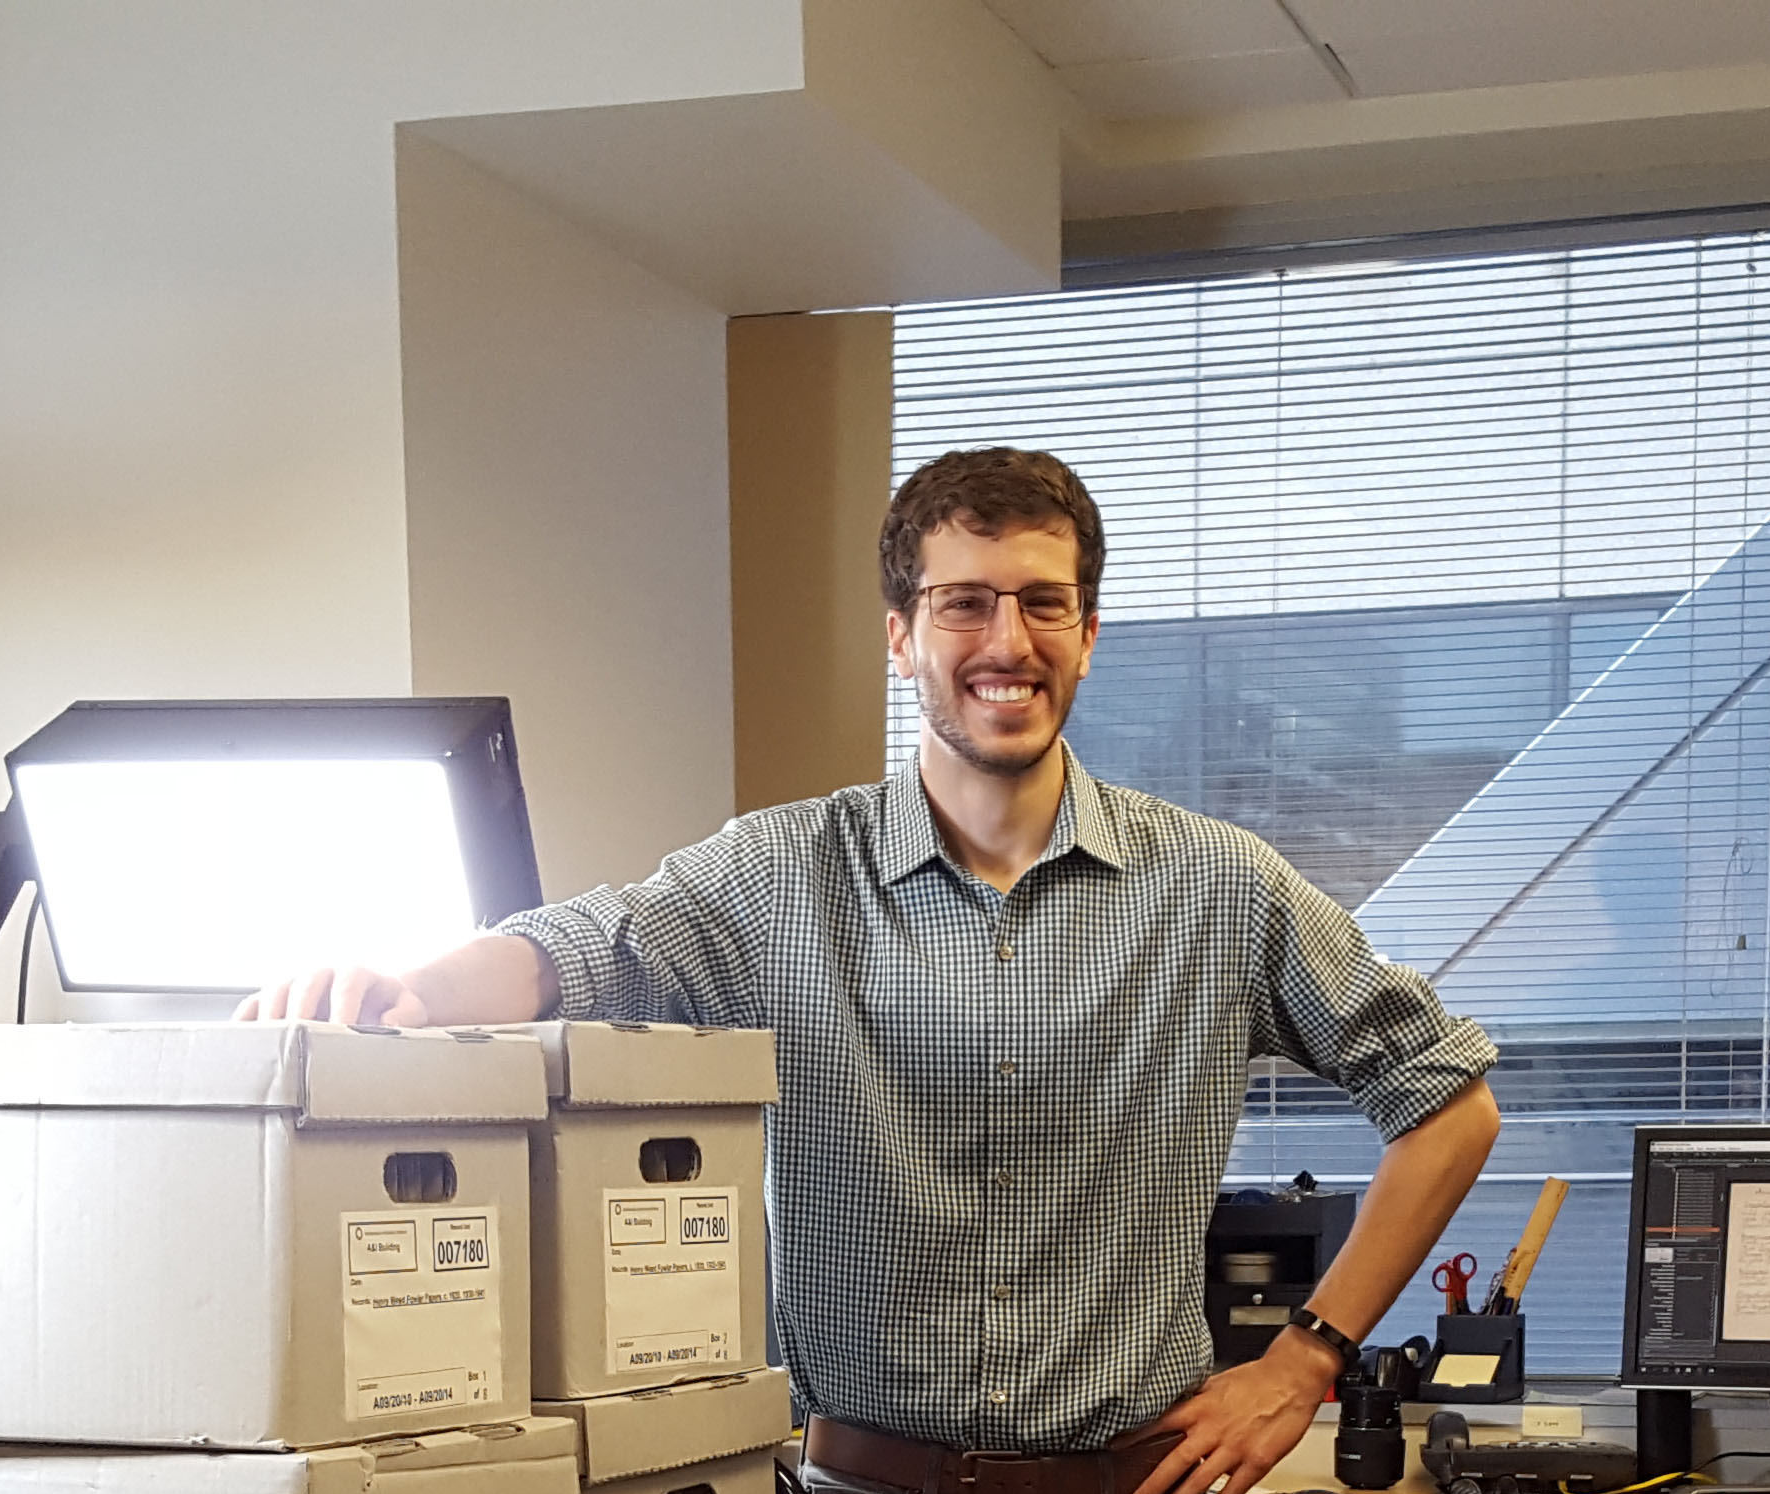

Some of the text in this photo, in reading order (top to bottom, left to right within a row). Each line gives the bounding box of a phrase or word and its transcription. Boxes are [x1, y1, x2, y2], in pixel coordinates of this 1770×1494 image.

[684, 1217, 726, 1238] 007180
[379, 1242, 400, 1253] Building
[438, 1239, 484, 1265] 007180
